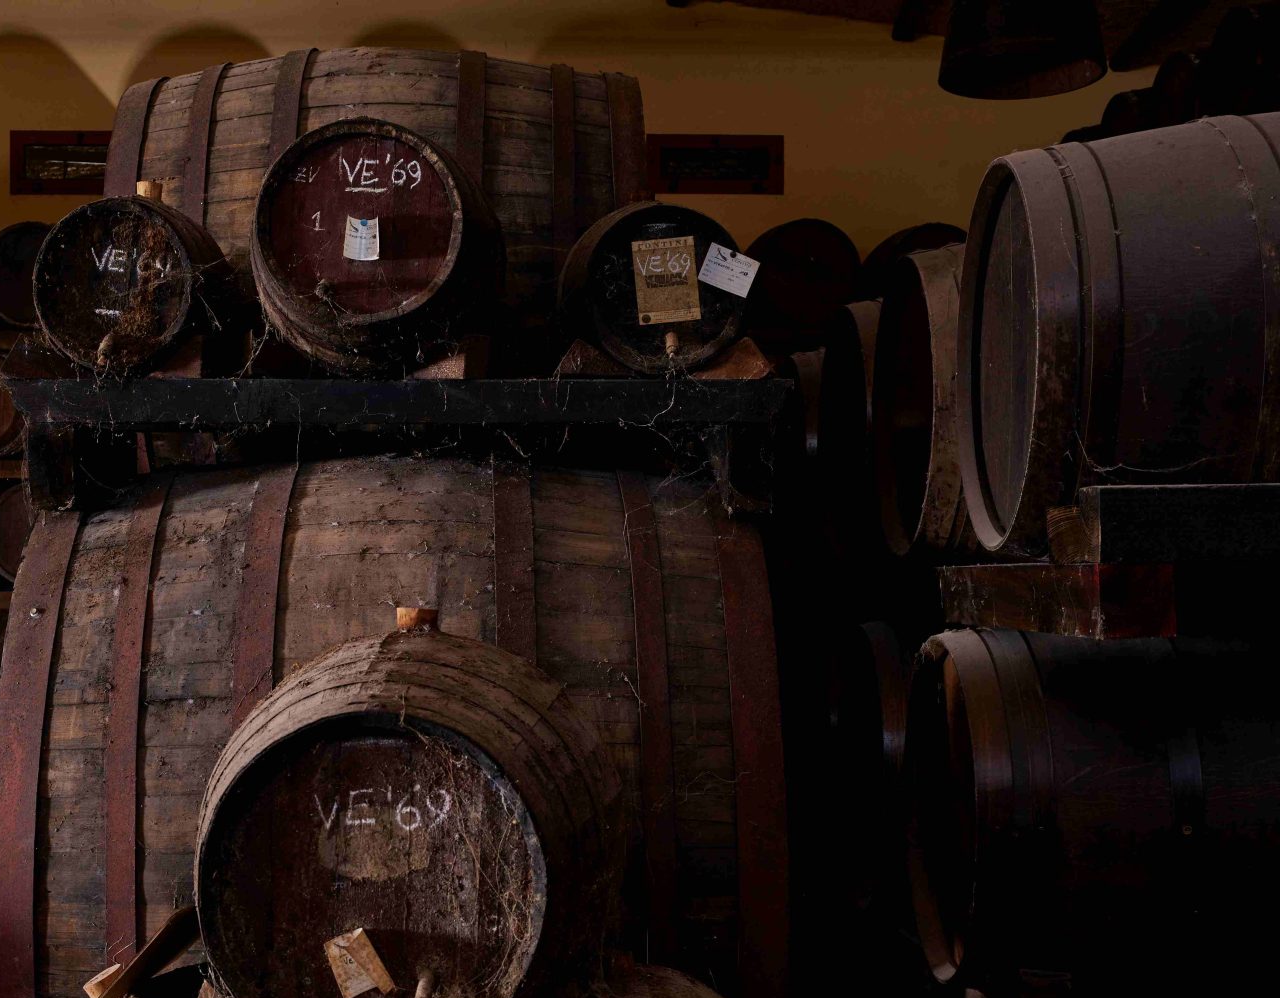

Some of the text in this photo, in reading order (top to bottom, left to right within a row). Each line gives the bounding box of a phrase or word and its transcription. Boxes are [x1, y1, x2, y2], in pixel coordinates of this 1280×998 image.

[340, 152, 422, 190] VE'69
[636, 250, 691, 278] VE'69
[313, 784, 452, 833] VE'69
